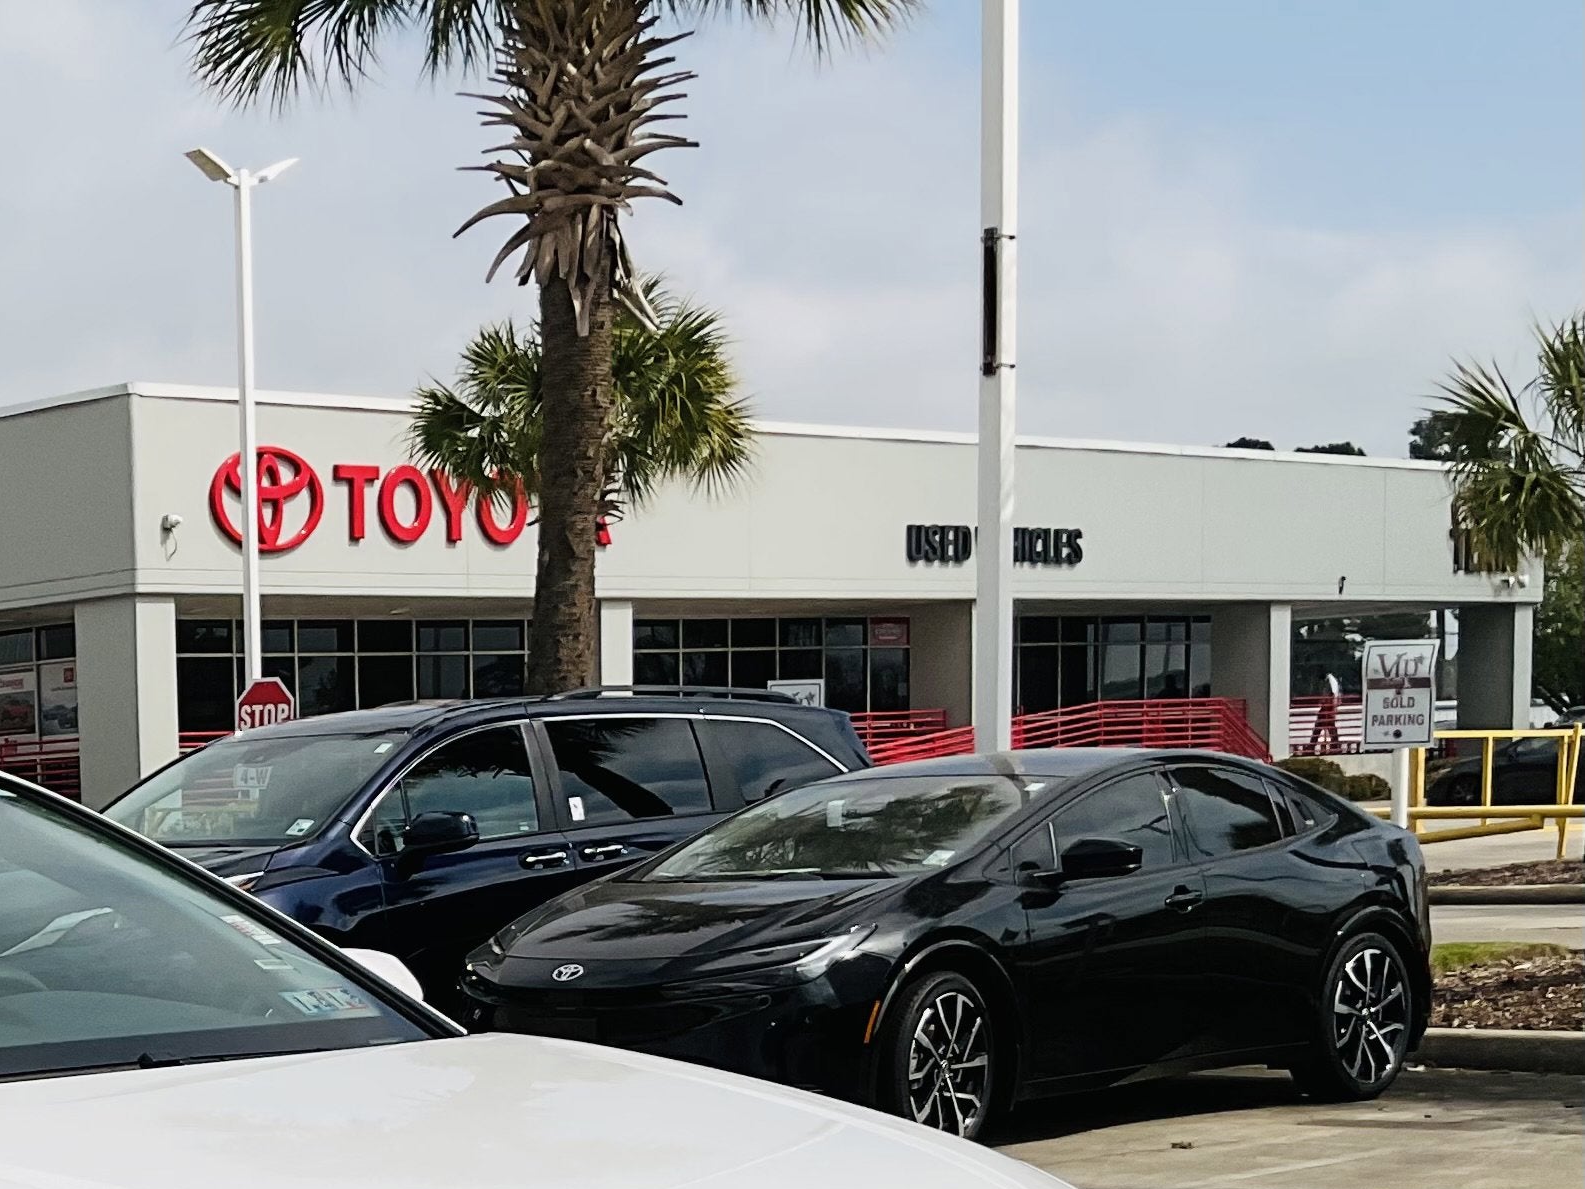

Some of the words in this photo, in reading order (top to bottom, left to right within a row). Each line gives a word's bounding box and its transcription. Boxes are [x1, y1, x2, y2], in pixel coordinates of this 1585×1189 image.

[333, 464, 612, 546] TOYO
[906, 524, 972, 562] USED
[974, 526, 1083, 565] HICLES
[240, 703, 289, 731] STOP
[1371, 713, 1425, 727] PARKING
